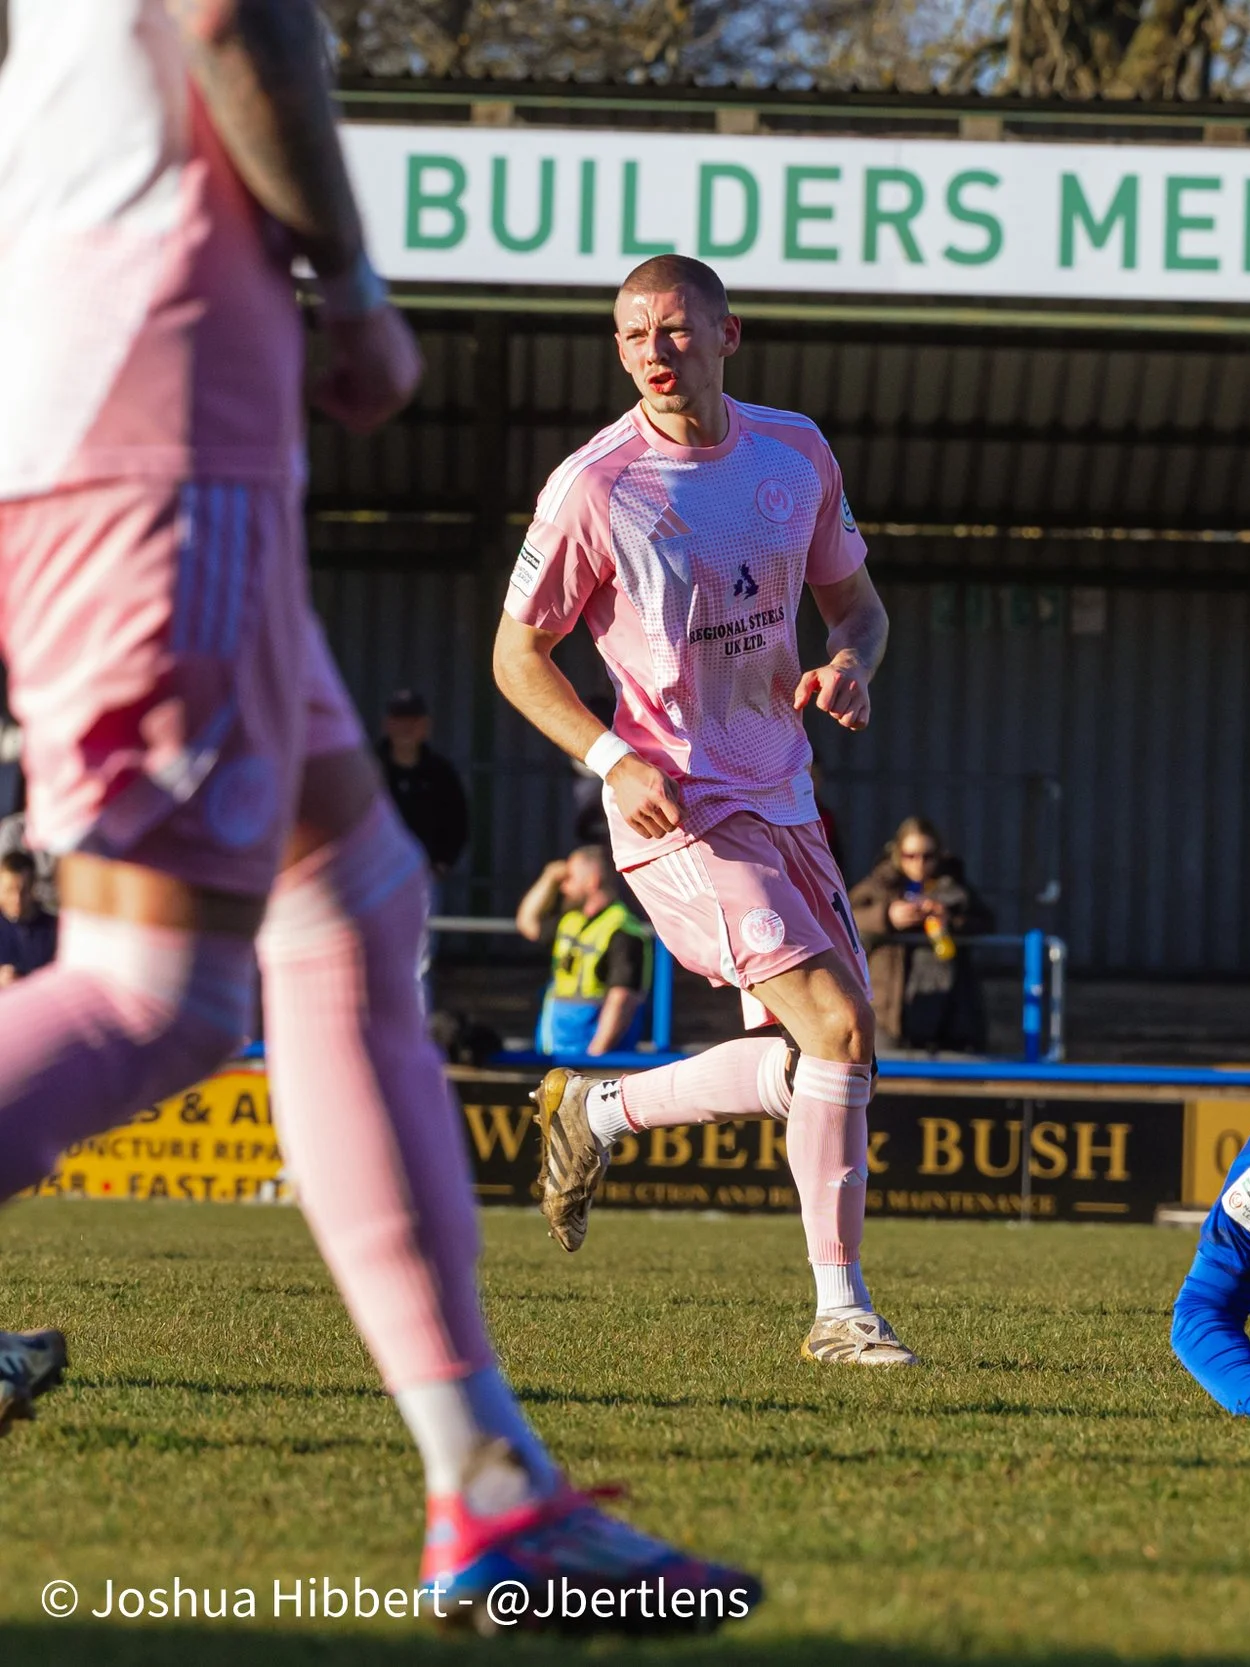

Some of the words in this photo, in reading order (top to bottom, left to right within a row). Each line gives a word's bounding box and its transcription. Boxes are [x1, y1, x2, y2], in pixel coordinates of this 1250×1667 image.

[405, 153, 1004, 267] BUILDERS
[689, 617, 748, 645] REGIONAL
[748, 605, 785, 630] STEELS
[725, 640, 741, 656] UK
[65, 1134, 201, 1162] UNCTURE
[213, 1139, 287, 1164] REPA
[917, 1116, 1133, 1182] BUSH
